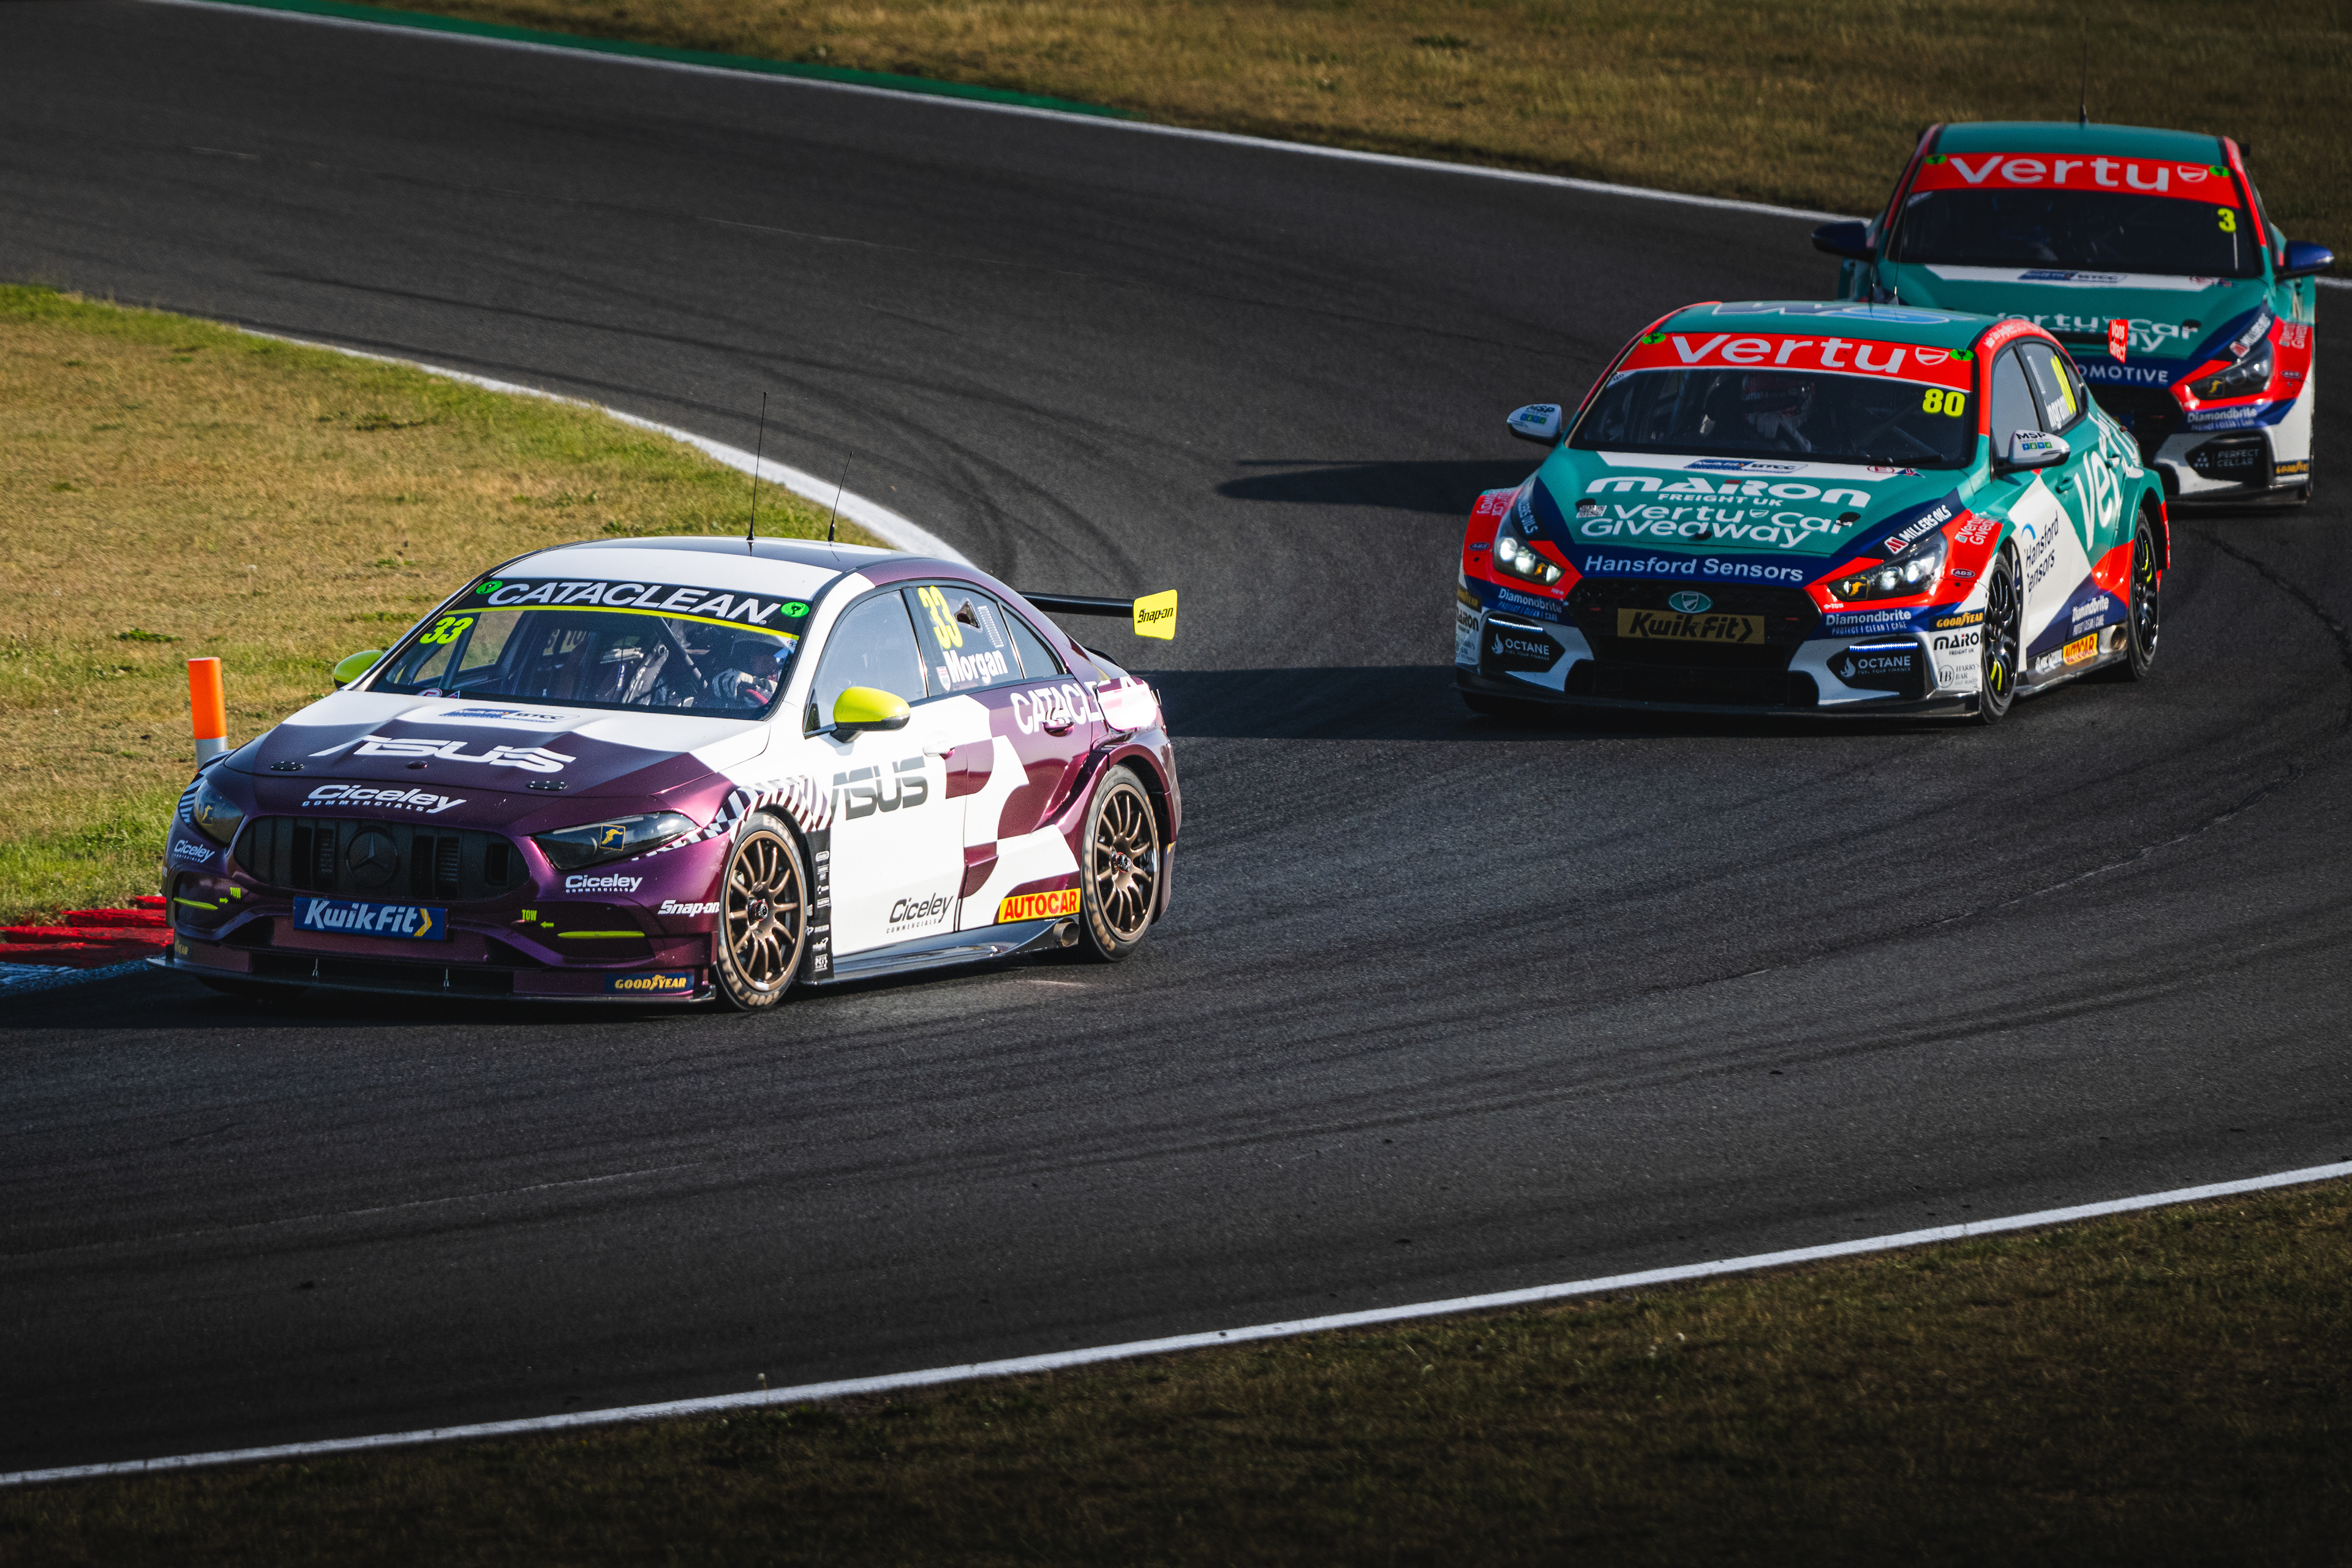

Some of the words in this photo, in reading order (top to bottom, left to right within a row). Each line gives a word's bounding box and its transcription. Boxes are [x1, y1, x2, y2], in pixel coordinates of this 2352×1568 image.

[1948, 155, 2169, 192] Vertu
[2218, 208, 2237, 233] 3
[1672, 334, 1906, 374] Vertu
[1922, 388, 1966, 417] 80
[2015, 431, 2046, 440] MSP
[2217, 458, 2253, 467] CELLAR
[2218, 448, 2260, 458] PERFECT
[1657, 492, 1747, 504] FREIGHT
[1753, 497, 1784, 507] UK
[1613, 503, 1745, 524] Vertu
[1898, 513, 1939, 543] MILLERS
[1932, 504, 1953, 523] OILS
[1580, 517, 1811, 548] Giveaway
[1584, 554, 1696, 575] Hansford
[1703, 558, 1804, 582] Sensors
[488, 582, 782, 624] CATACLEAN
[918, 585, 963, 650] 33
[1137, 607, 1174, 624] Snap-on
[1825, 609, 1912, 626] Diamondbrite
[419, 616, 474, 645] 33
[1505, 638, 1550, 655] OCTANE
[942, 649, 1009, 684] Morgan
[1858, 656, 1911, 669] OCTANE
[307, 734, 576, 773] ASUS
[307, 785, 467, 813] Ciceley
[831, 756, 927, 821] ASUS
[301, 800, 424, 812] COMMERCIALS
[174, 839, 216, 863] Ciceley
[565, 873, 643, 892] Ciceley
[522, 909, 538, 922] TOW
[657, 899, 720, 918] Snap-on
[889, 892, 954, 924] Ciceley
[1003, 889, 1077, 921] AUTOCAR
[886, 918, 939, 935] COMMERCIALS
[614, 974, 687, 991] GOODYEAR
